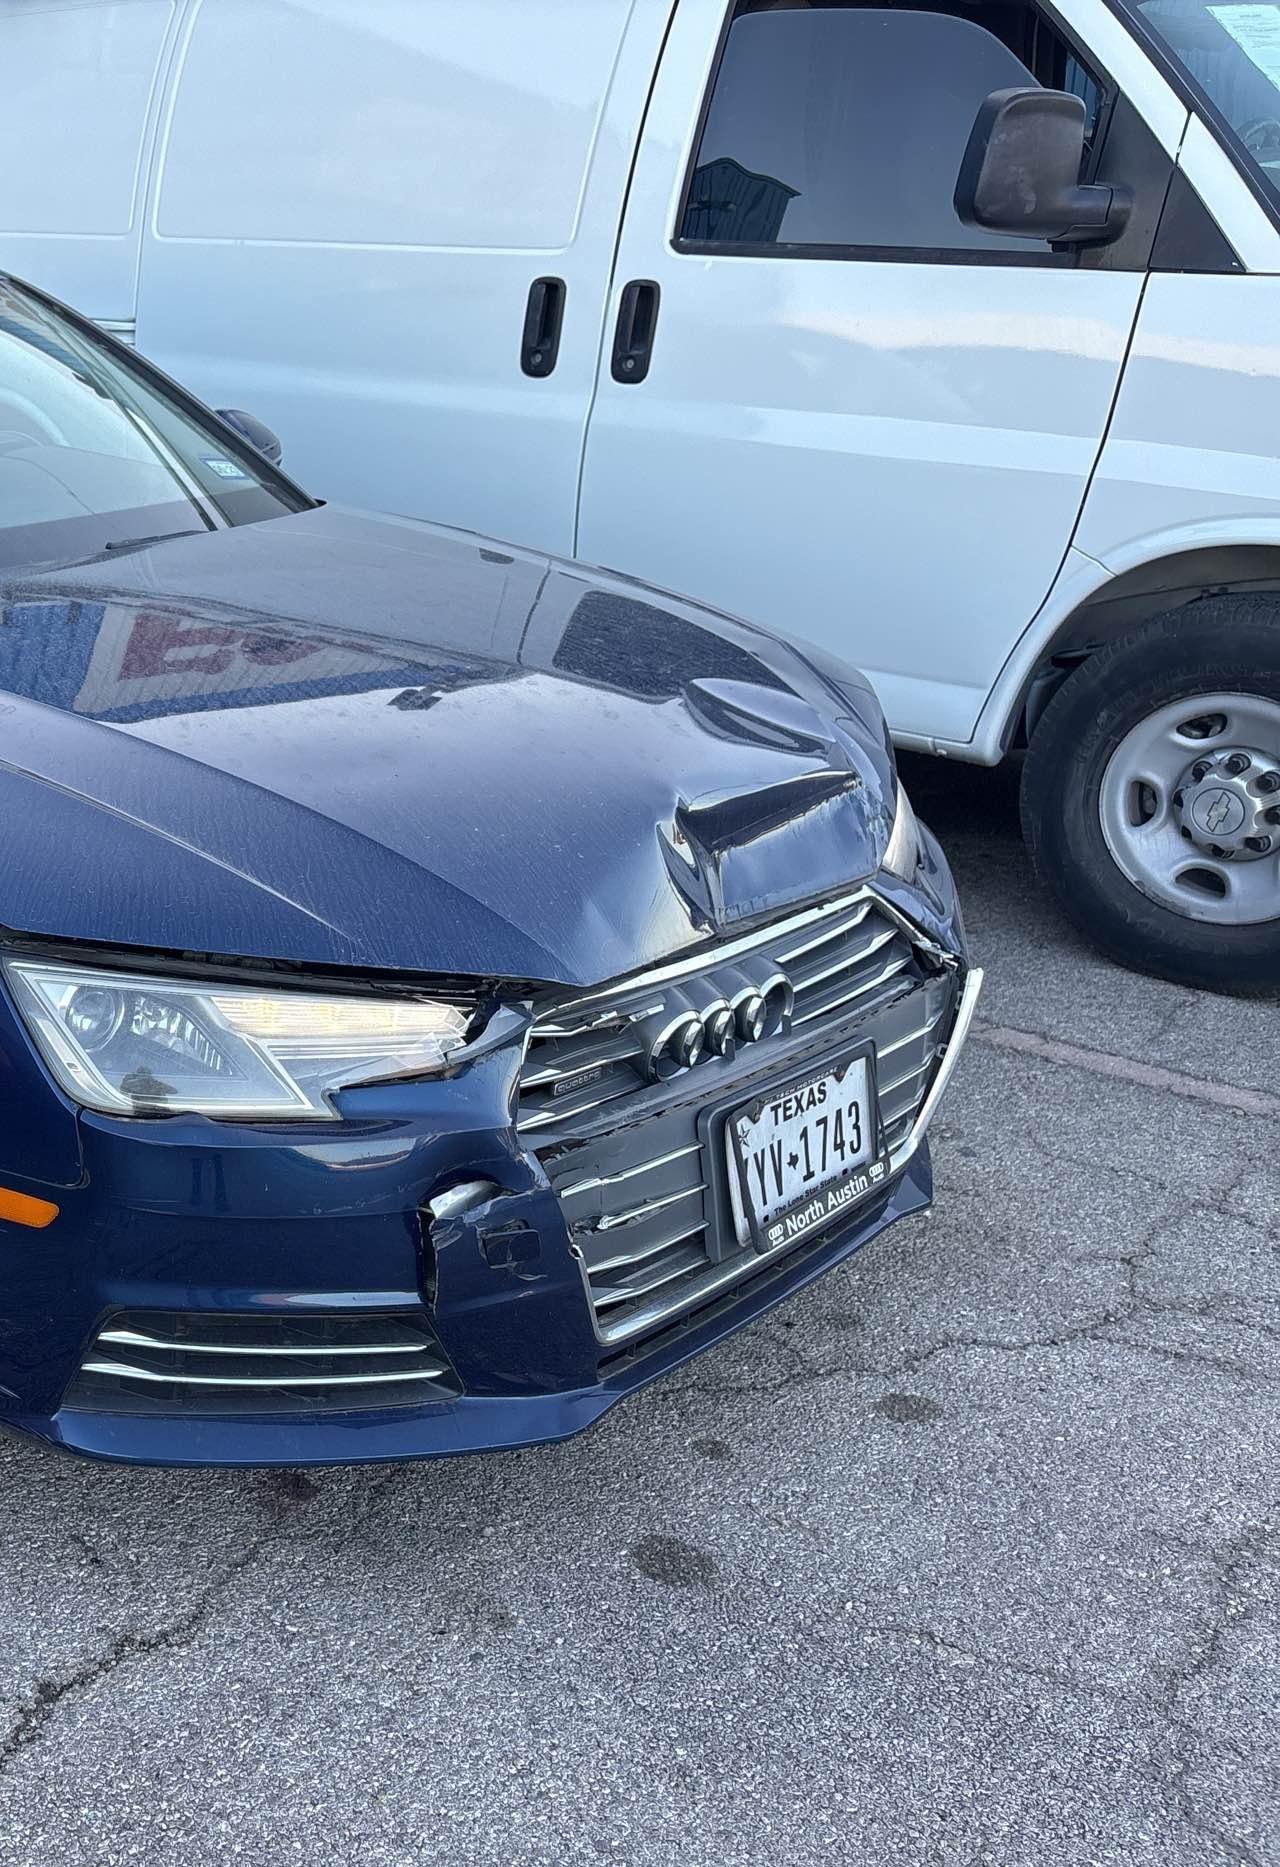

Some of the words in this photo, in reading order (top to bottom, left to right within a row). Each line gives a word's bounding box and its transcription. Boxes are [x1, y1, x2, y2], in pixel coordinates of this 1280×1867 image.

[770, 1081, 827, 1126] TEXAS
[744, 1139, 783, 1207] YV
[799, 1101, 862, 1183] 1743
[774, 1204, 787, 1215] The
[787, 1194, 804, 1207] Lone
[805, 1185, 819, 1198] Star
[820, 1175, 838, 1189] State
[785, 1200, 825, 1236] North
[827, 1175, 868, 1210] Austin
